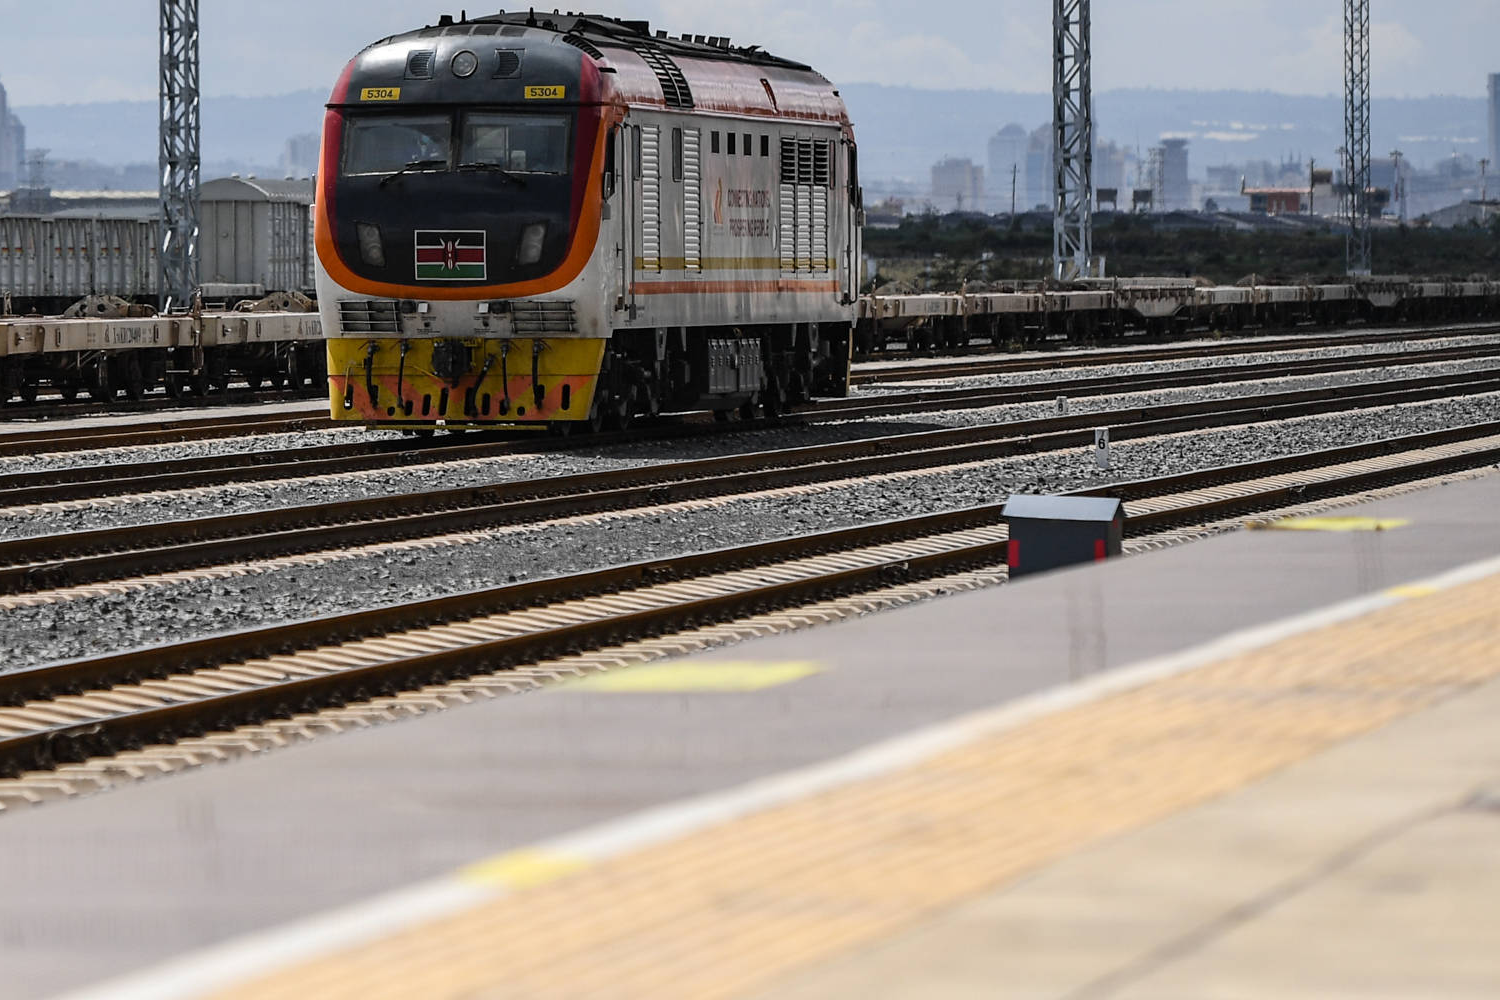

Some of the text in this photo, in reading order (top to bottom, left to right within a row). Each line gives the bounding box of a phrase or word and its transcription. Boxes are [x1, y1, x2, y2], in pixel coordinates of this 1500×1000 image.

[367, 89, 394, 99] 5304
[530, 87, 558, 97] 5304
[1098, 438, 1106, 450] 6
